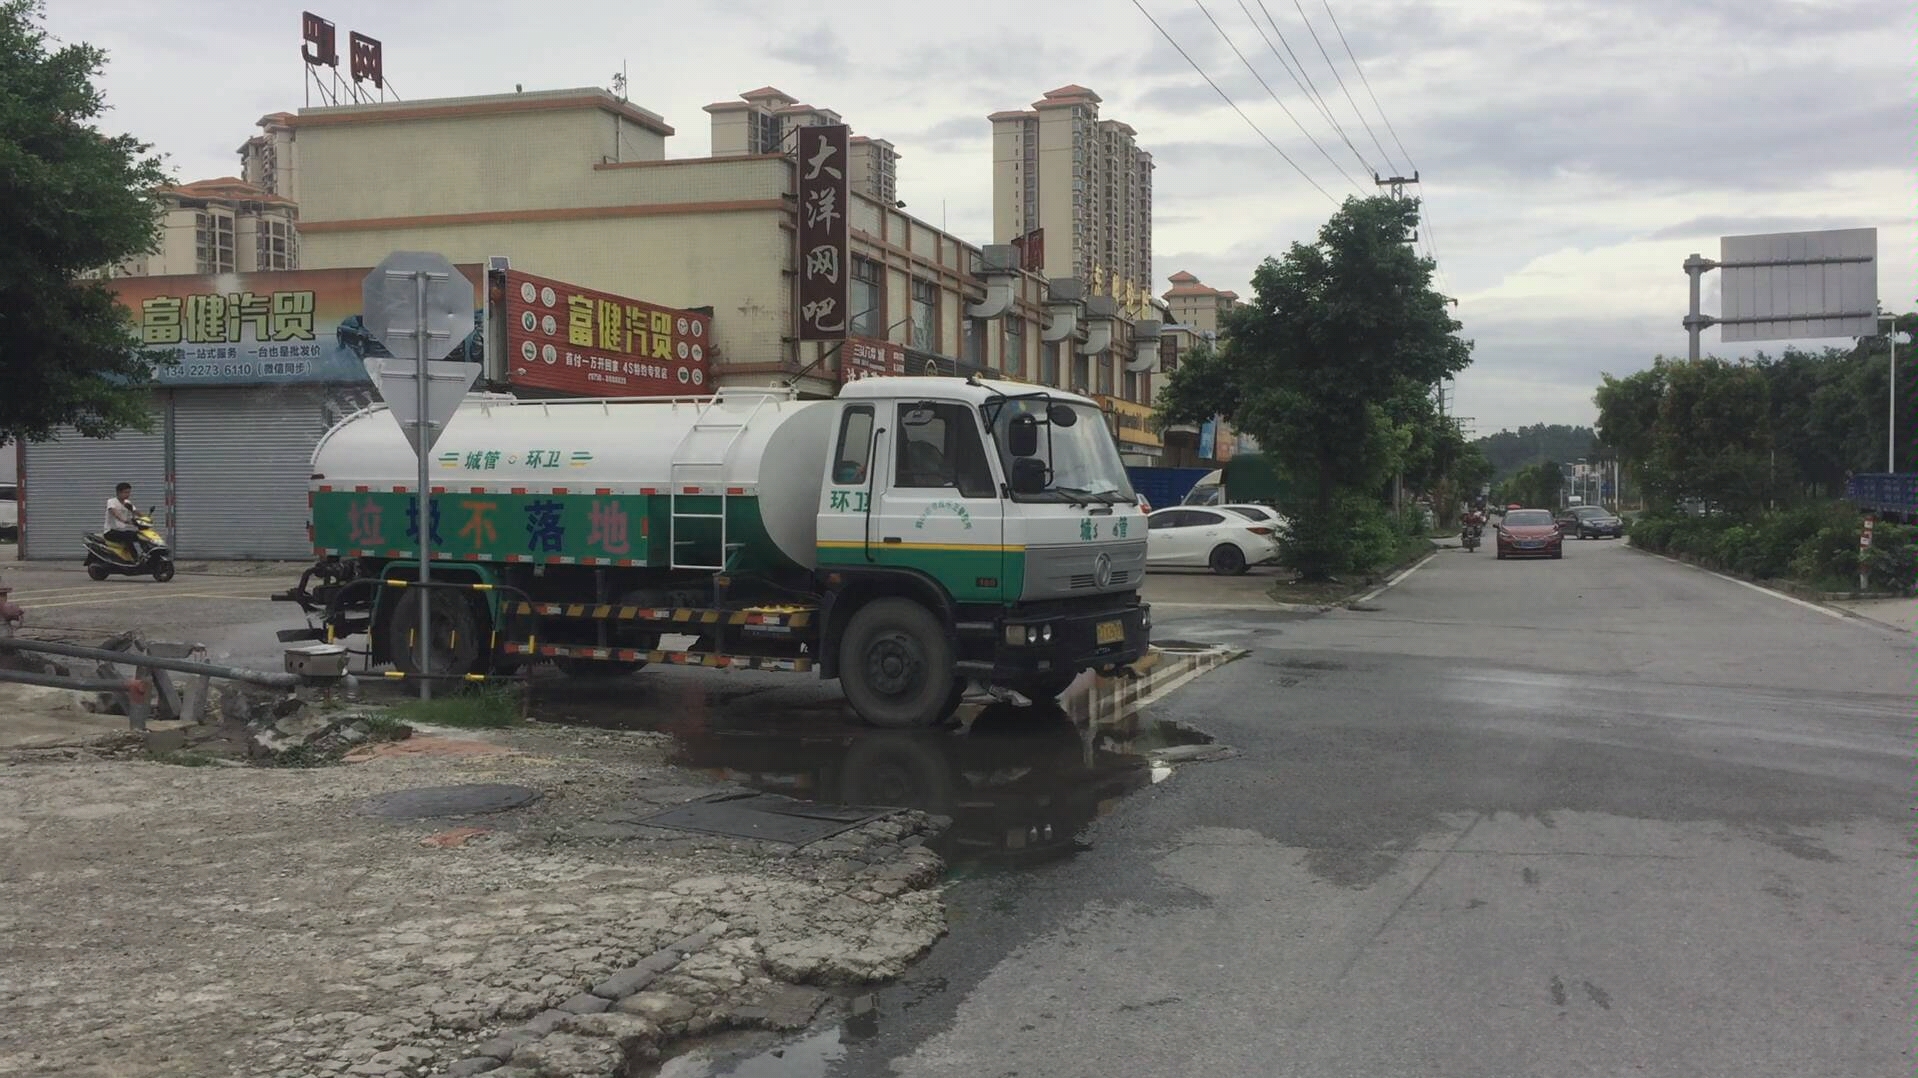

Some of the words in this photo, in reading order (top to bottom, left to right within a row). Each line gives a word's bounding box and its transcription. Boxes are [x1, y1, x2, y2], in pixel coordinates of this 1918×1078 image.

[802, 135, 845, 331] 大洋网吧
[141, 291, 316, 344] 富健汽贸
[568, 294, 672, 361] 富健汽贸
[248, 345, 321, 358] 一台也是批发价
[165, 366, 185, 378] 134
[190, 365, 220, 377] 2273
[224, 364, 252, 376] 6110
[465, 450, 501, 470] 城管
[526, 450, 562, 469] 环卫
[831, 491, 870, 513] 环卫
[348, 496, 631, 554] 垃圾不落地
